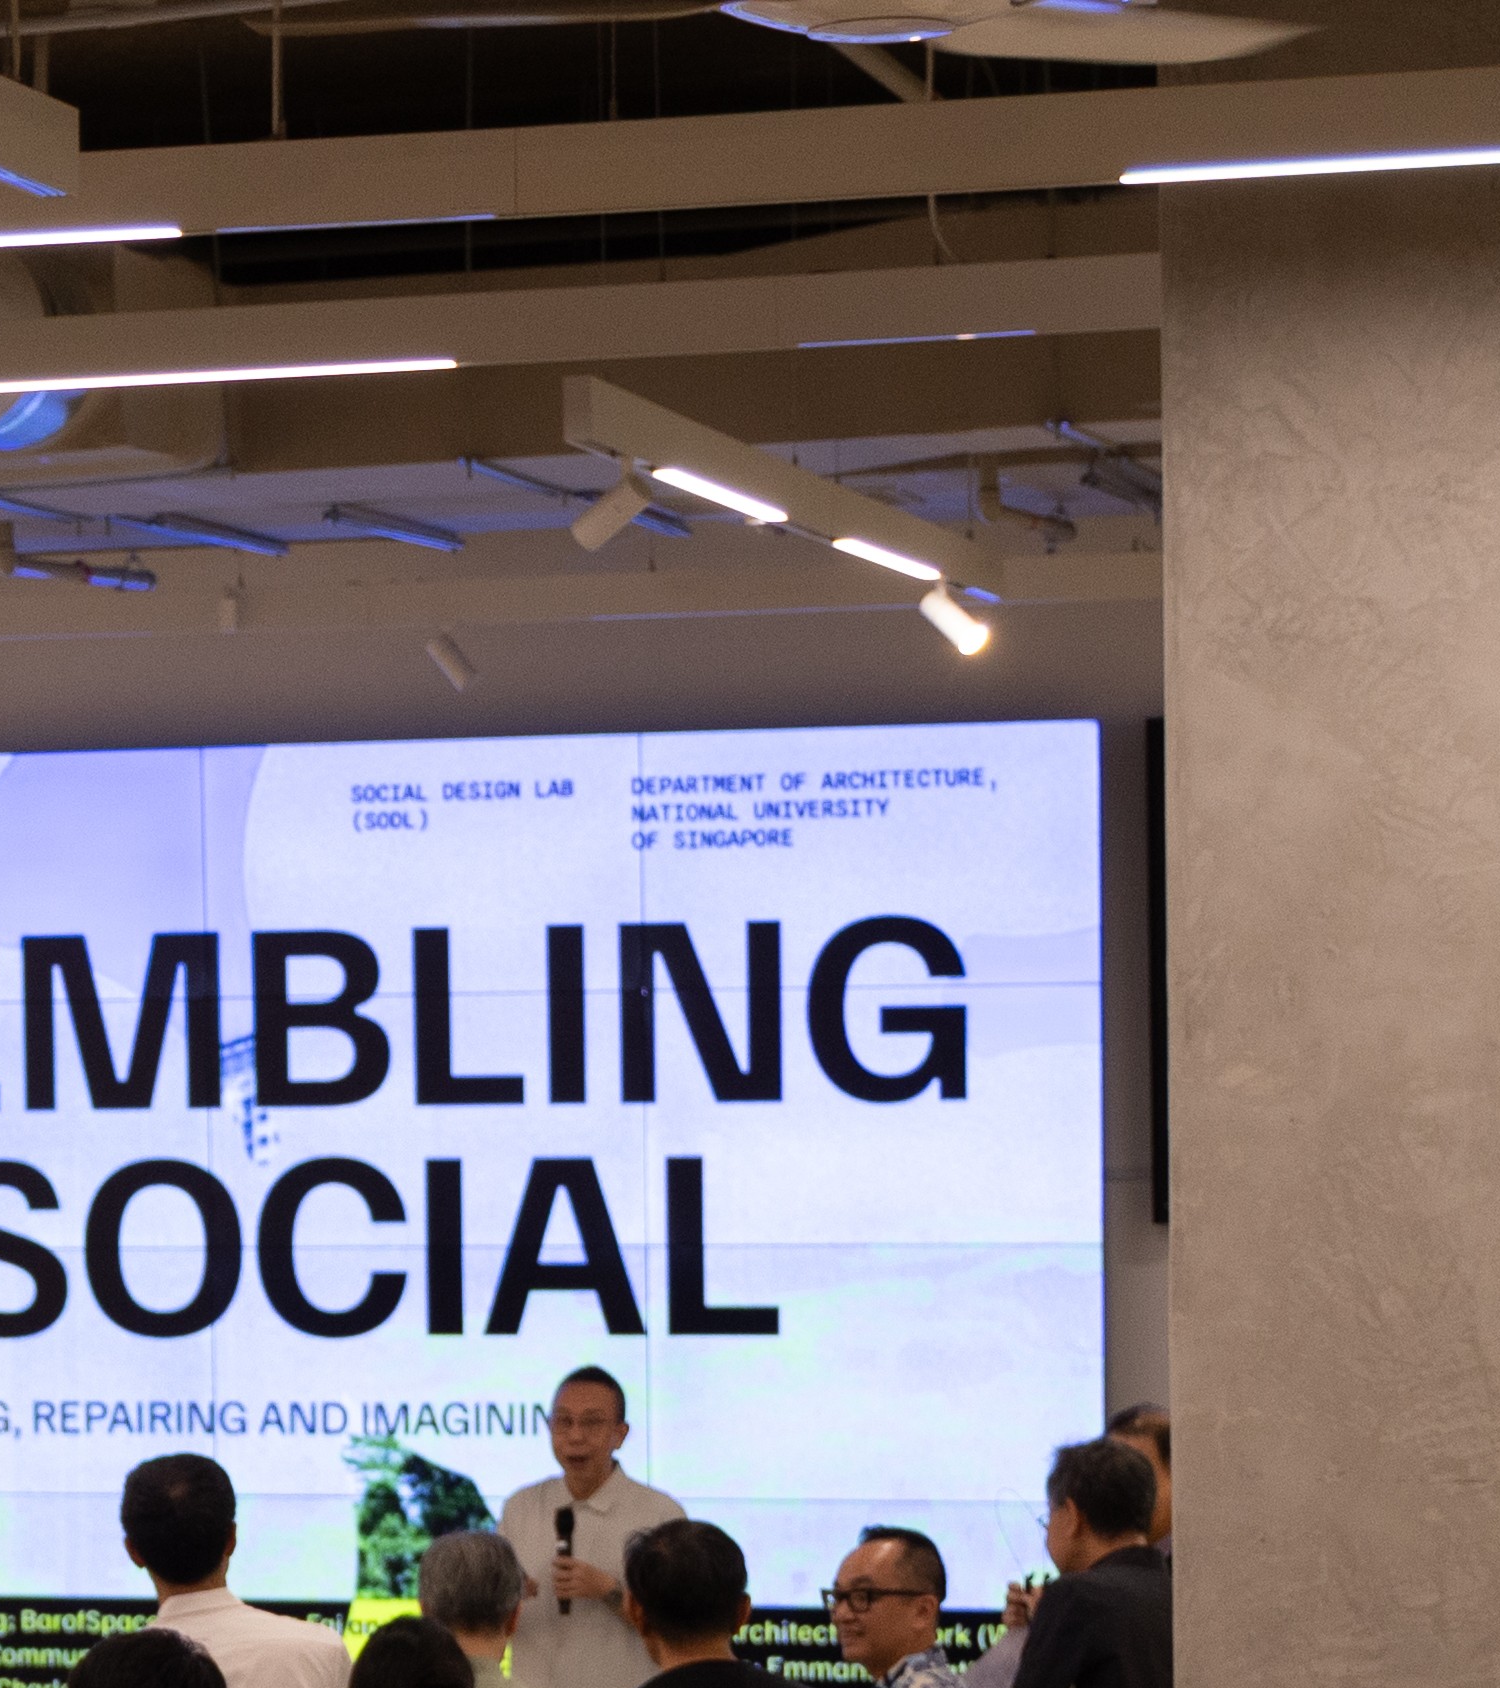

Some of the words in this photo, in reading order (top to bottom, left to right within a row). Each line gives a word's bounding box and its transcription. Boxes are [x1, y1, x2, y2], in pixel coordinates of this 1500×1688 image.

[351, 783, 427, 803] SOCIAL
[442, 780, 522, 801] DESIGN
[534, 778, 574, 799] LAB
[631, 773, 765, 797] DEPARTMENT
[779, 772, 806, 792] OF
[820, 767, 998, 792] ARCHITECTURE,
[352, 808, 429, 832] (SODL)
[631, 803, 738, 824] NATIONAL
[753, 797, 889, 820] UNIVERSITY
[631, 830, 657, 853] OF
[673, 828, 792, 850] SINGAPORE
[32, 1399, 248, 1435] REPAIRING
[259, 1400, 349, 1435] AND
[362, 1401, 551, 1436] IMAGININ
